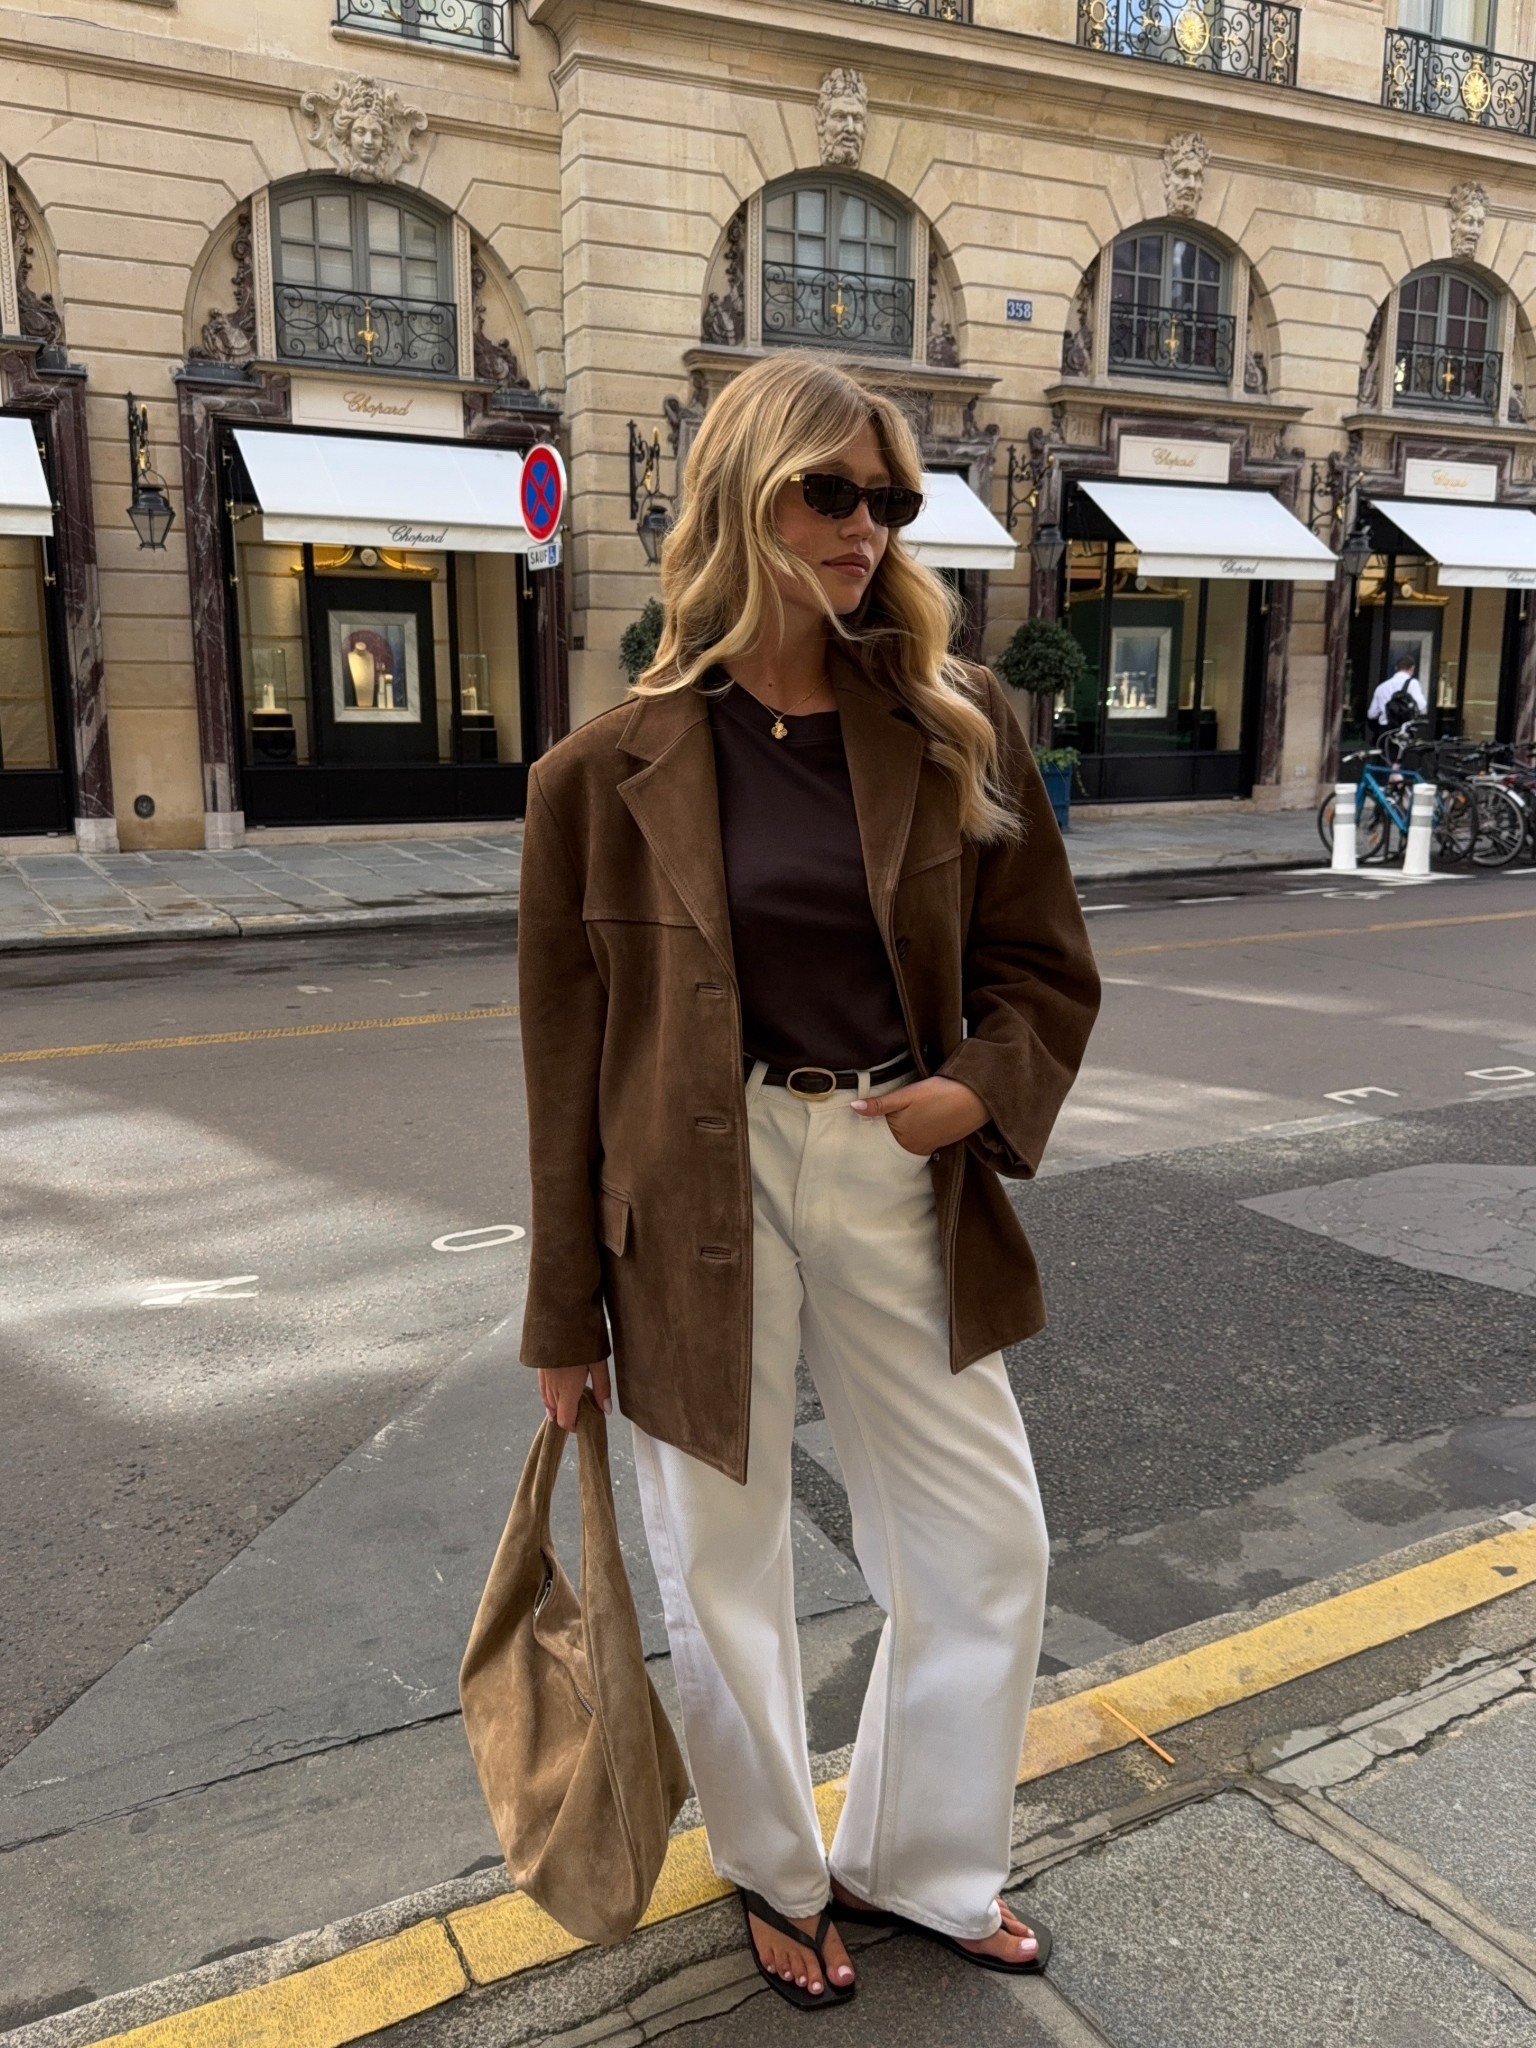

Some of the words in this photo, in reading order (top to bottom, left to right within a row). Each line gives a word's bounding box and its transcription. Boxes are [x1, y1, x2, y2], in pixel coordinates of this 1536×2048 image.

[1008, 301, 1031, 319] 358
[343, 391, 414, 418] Chopard
[387, 524, 449, 546] Chopard
[530, 549, 548, 565] SAUF
